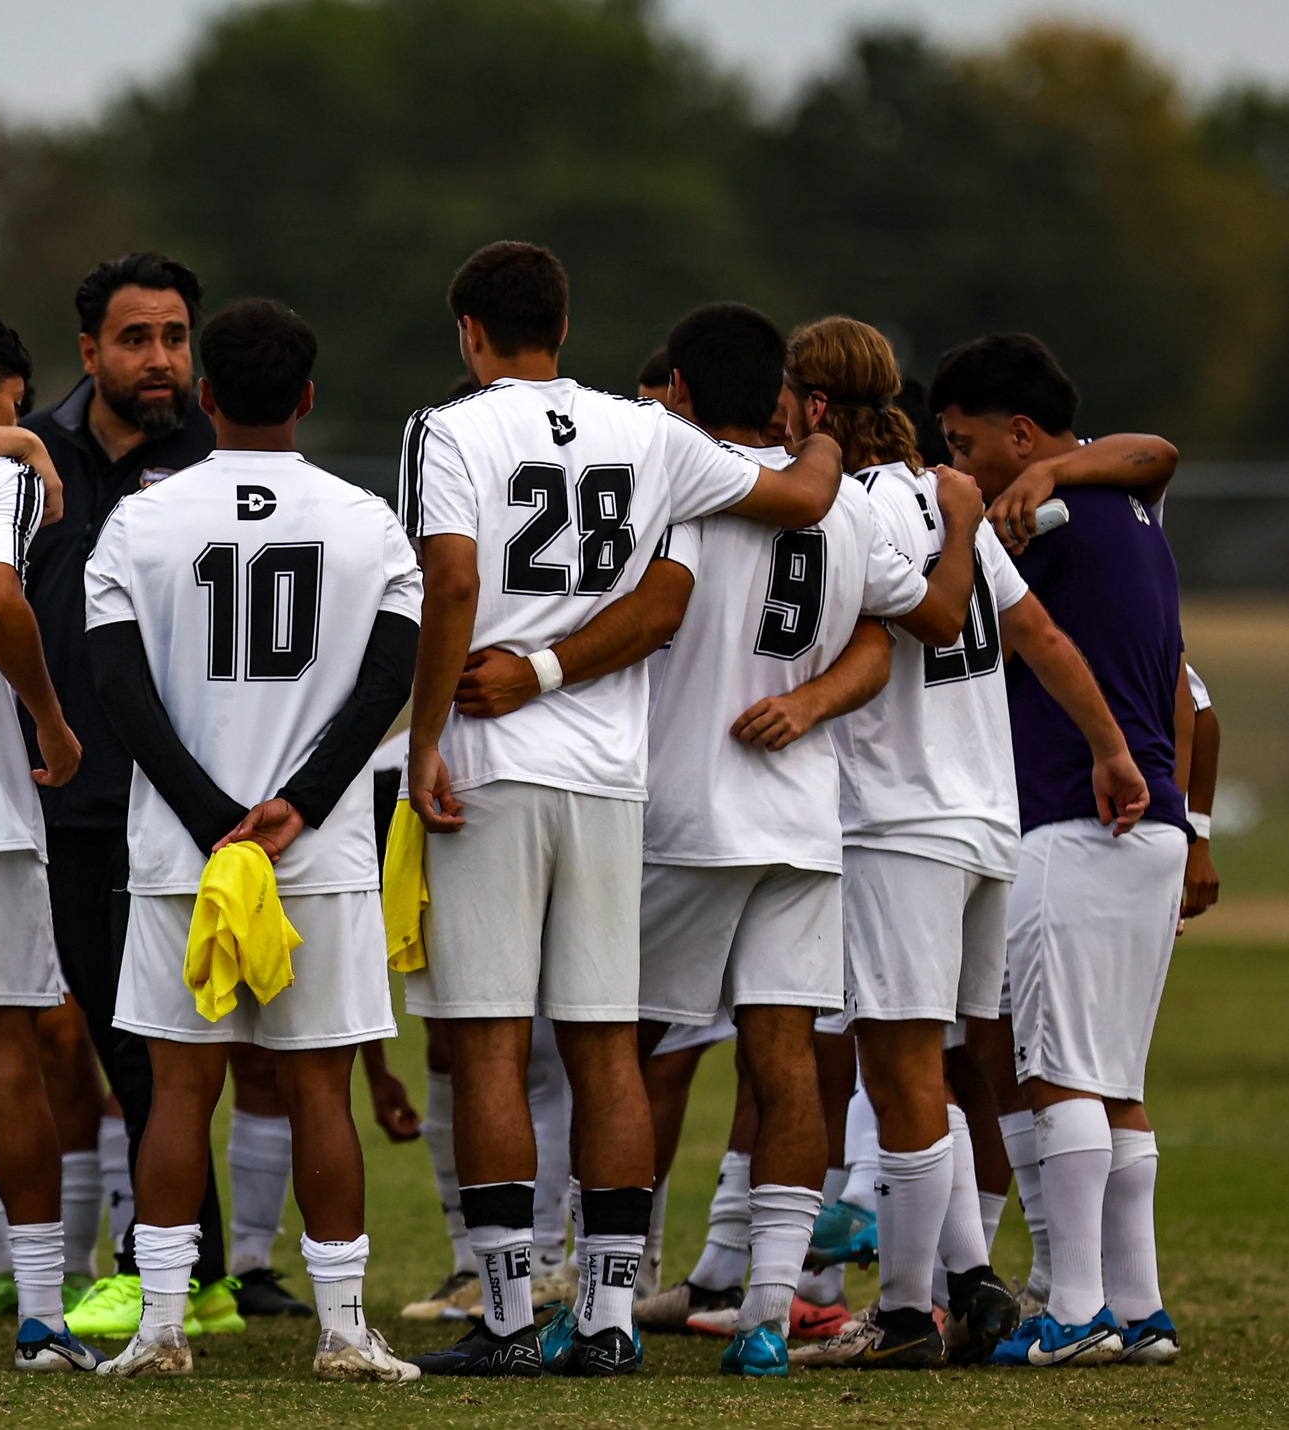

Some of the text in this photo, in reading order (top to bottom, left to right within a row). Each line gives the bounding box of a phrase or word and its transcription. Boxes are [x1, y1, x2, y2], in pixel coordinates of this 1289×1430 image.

[502, 461, 636, 596] 28
[753, 529, 827, 661] 9
[193, 541, 324, 682] 10
